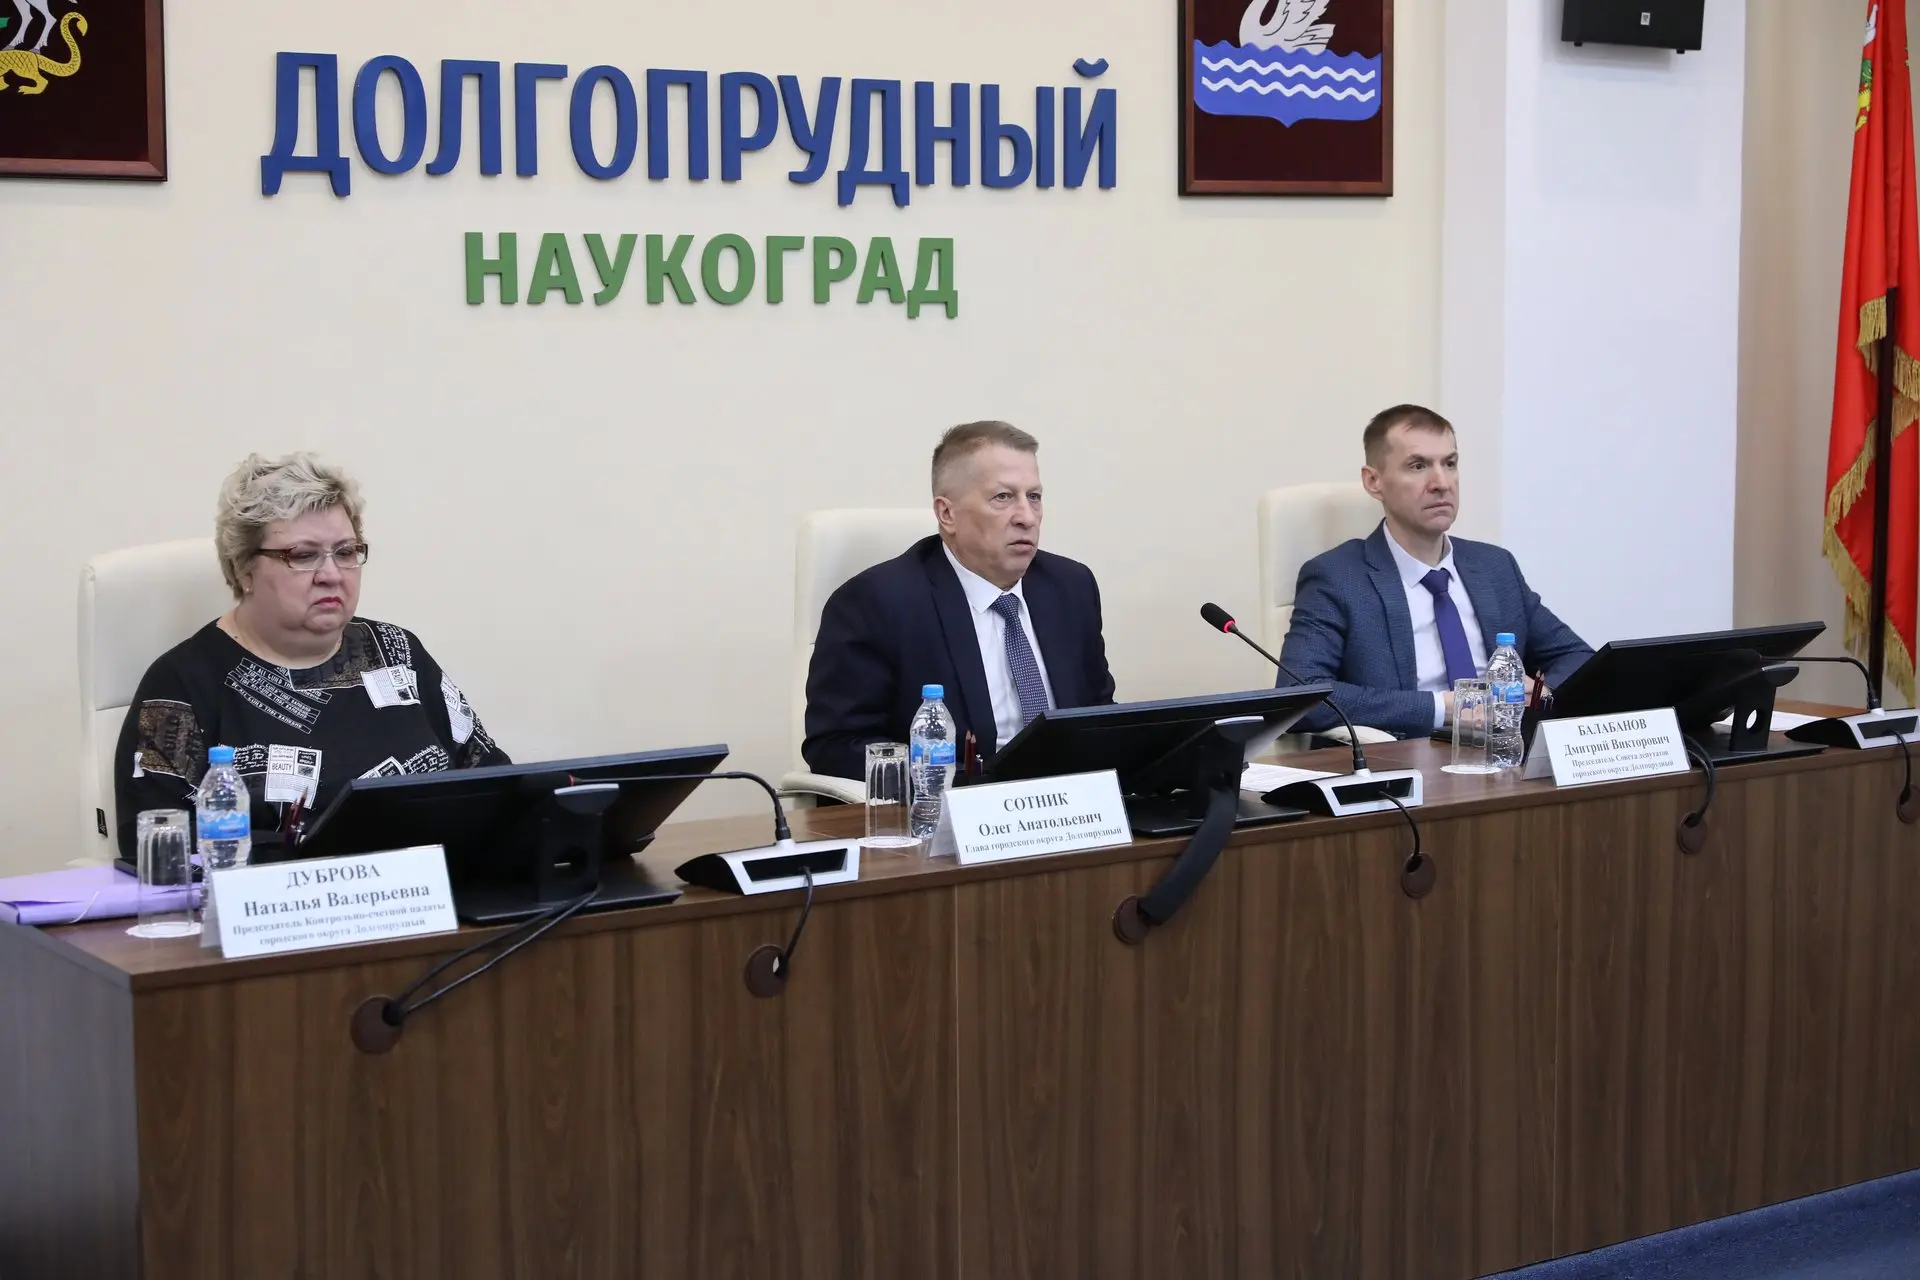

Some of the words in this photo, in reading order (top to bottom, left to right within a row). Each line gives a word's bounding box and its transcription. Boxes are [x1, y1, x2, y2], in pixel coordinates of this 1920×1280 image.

[261, 52, 1117, 207] ДОЛГОПРУДНЫЙ
[465, 232, 959, 318] НАУКОГРАД
[1577, 718, 1647, 736] БАЛАБАНОВ
[1564, 741, 1610, 756] Дмитрий
[1611, 735, 1670, 750] Викторович
[271, 762, 293, 771] BEAUTY
[1571, 757, 1614, 768] Председатель
[1615, 754, 1638, 763] Совета
[1639, 750, 1669, 760] депутатов
[1572, 768, 1606, 779] городского
[1607, 766, 1629, 775] округа
[1630, 760, 1674, 772] Долгопрудный
[1003, 792, 1069, 812] СОТНИК
[978, 823, 1012, 837] Олег
[1017, 812, 1102, 833] Анатольевич
[965, 844, 989, 853] Глава
[991, 838, 1035, 851] городского
[1036, 834, 1064, 847] округа
[1065, 827, 1122, 843] Долгопрудный
[287, 864, 381, 889] ДУБРОВА
[244, 898, 321, 917] Наталья
[327, 885, 430, 907] Валерьевна
[232, 920, 302, 936] Председатель
[305, 907, 408, 926] Контрольно-счетной
[410, 903, 446, 914] палаты
[259, 931, 315, 947] городского
[317, 926, 351, 940] округа
